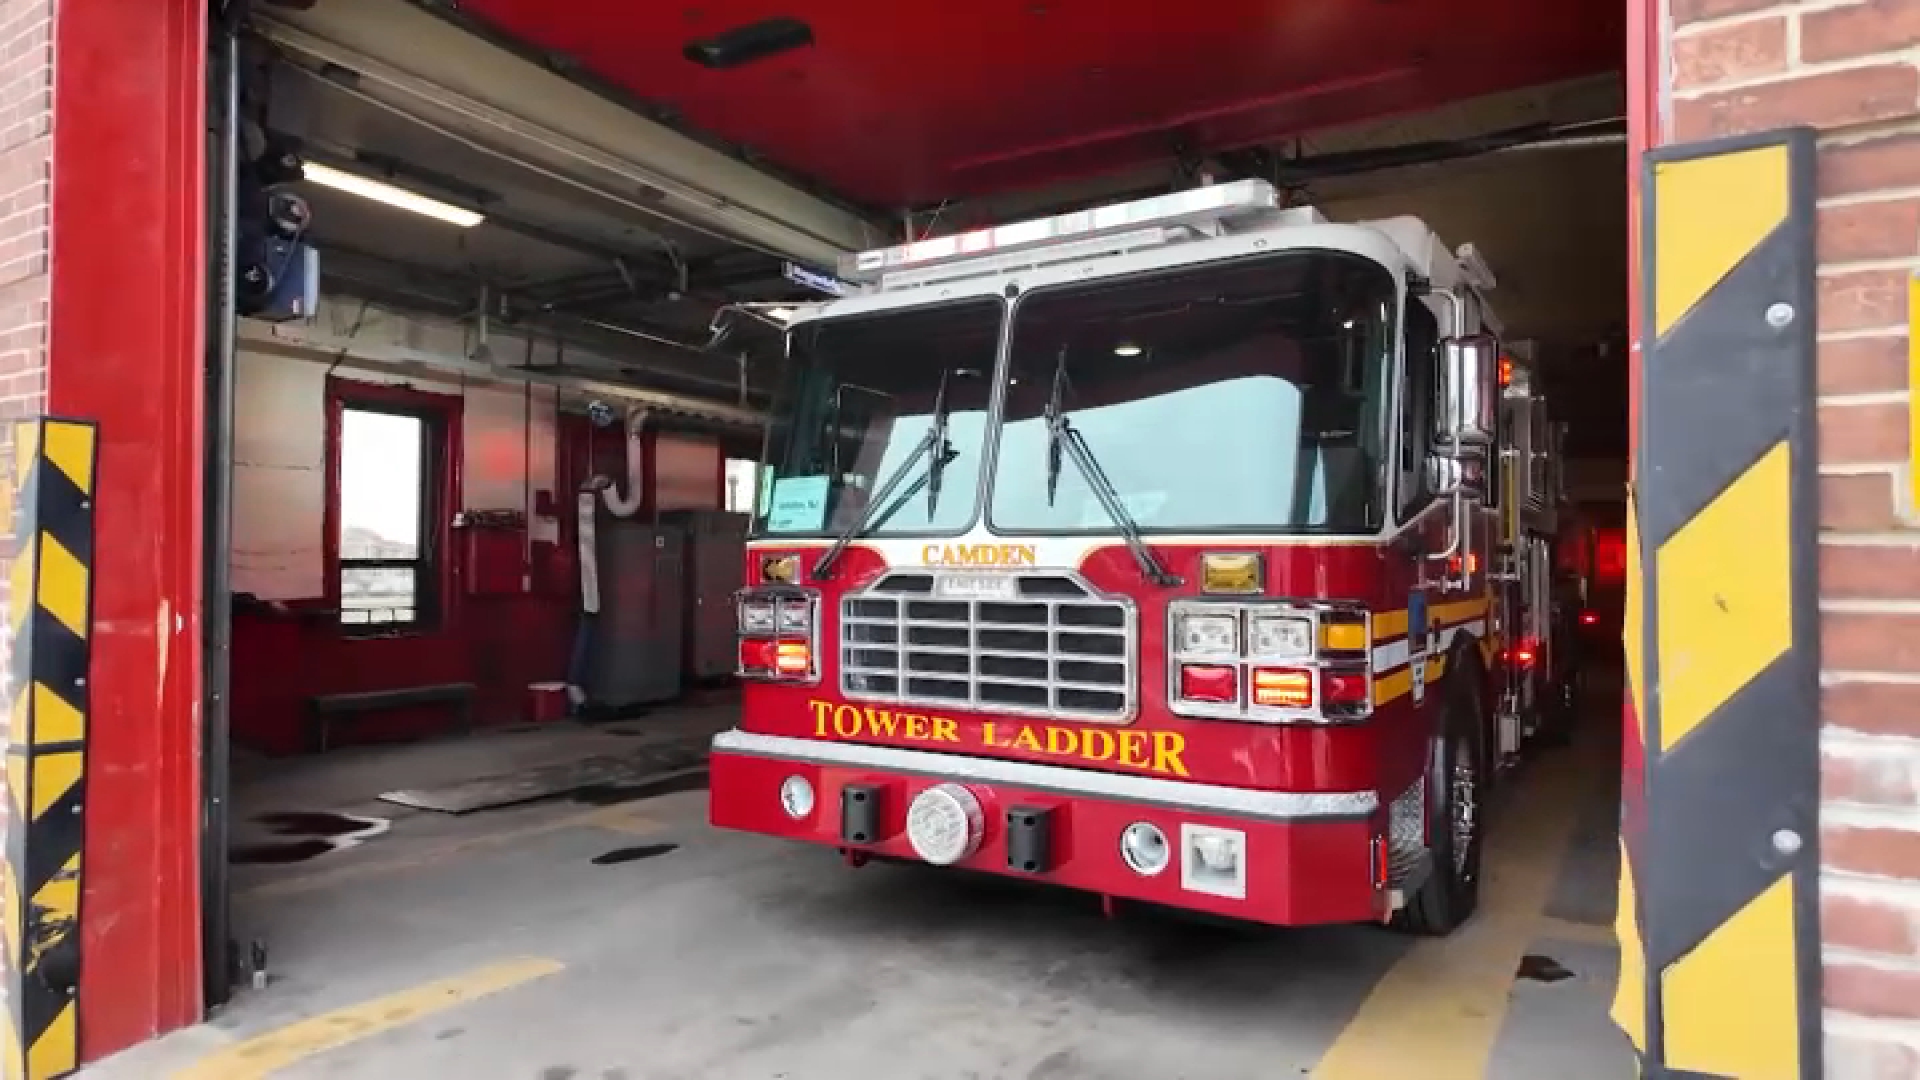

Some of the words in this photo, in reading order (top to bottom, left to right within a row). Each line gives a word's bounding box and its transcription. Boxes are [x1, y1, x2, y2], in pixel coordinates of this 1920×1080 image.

[922, 544, 1036, 565] CAMDEN
[810, 699, 960, 742] TOWER
[982, 721, 1190, 776] LADDER
